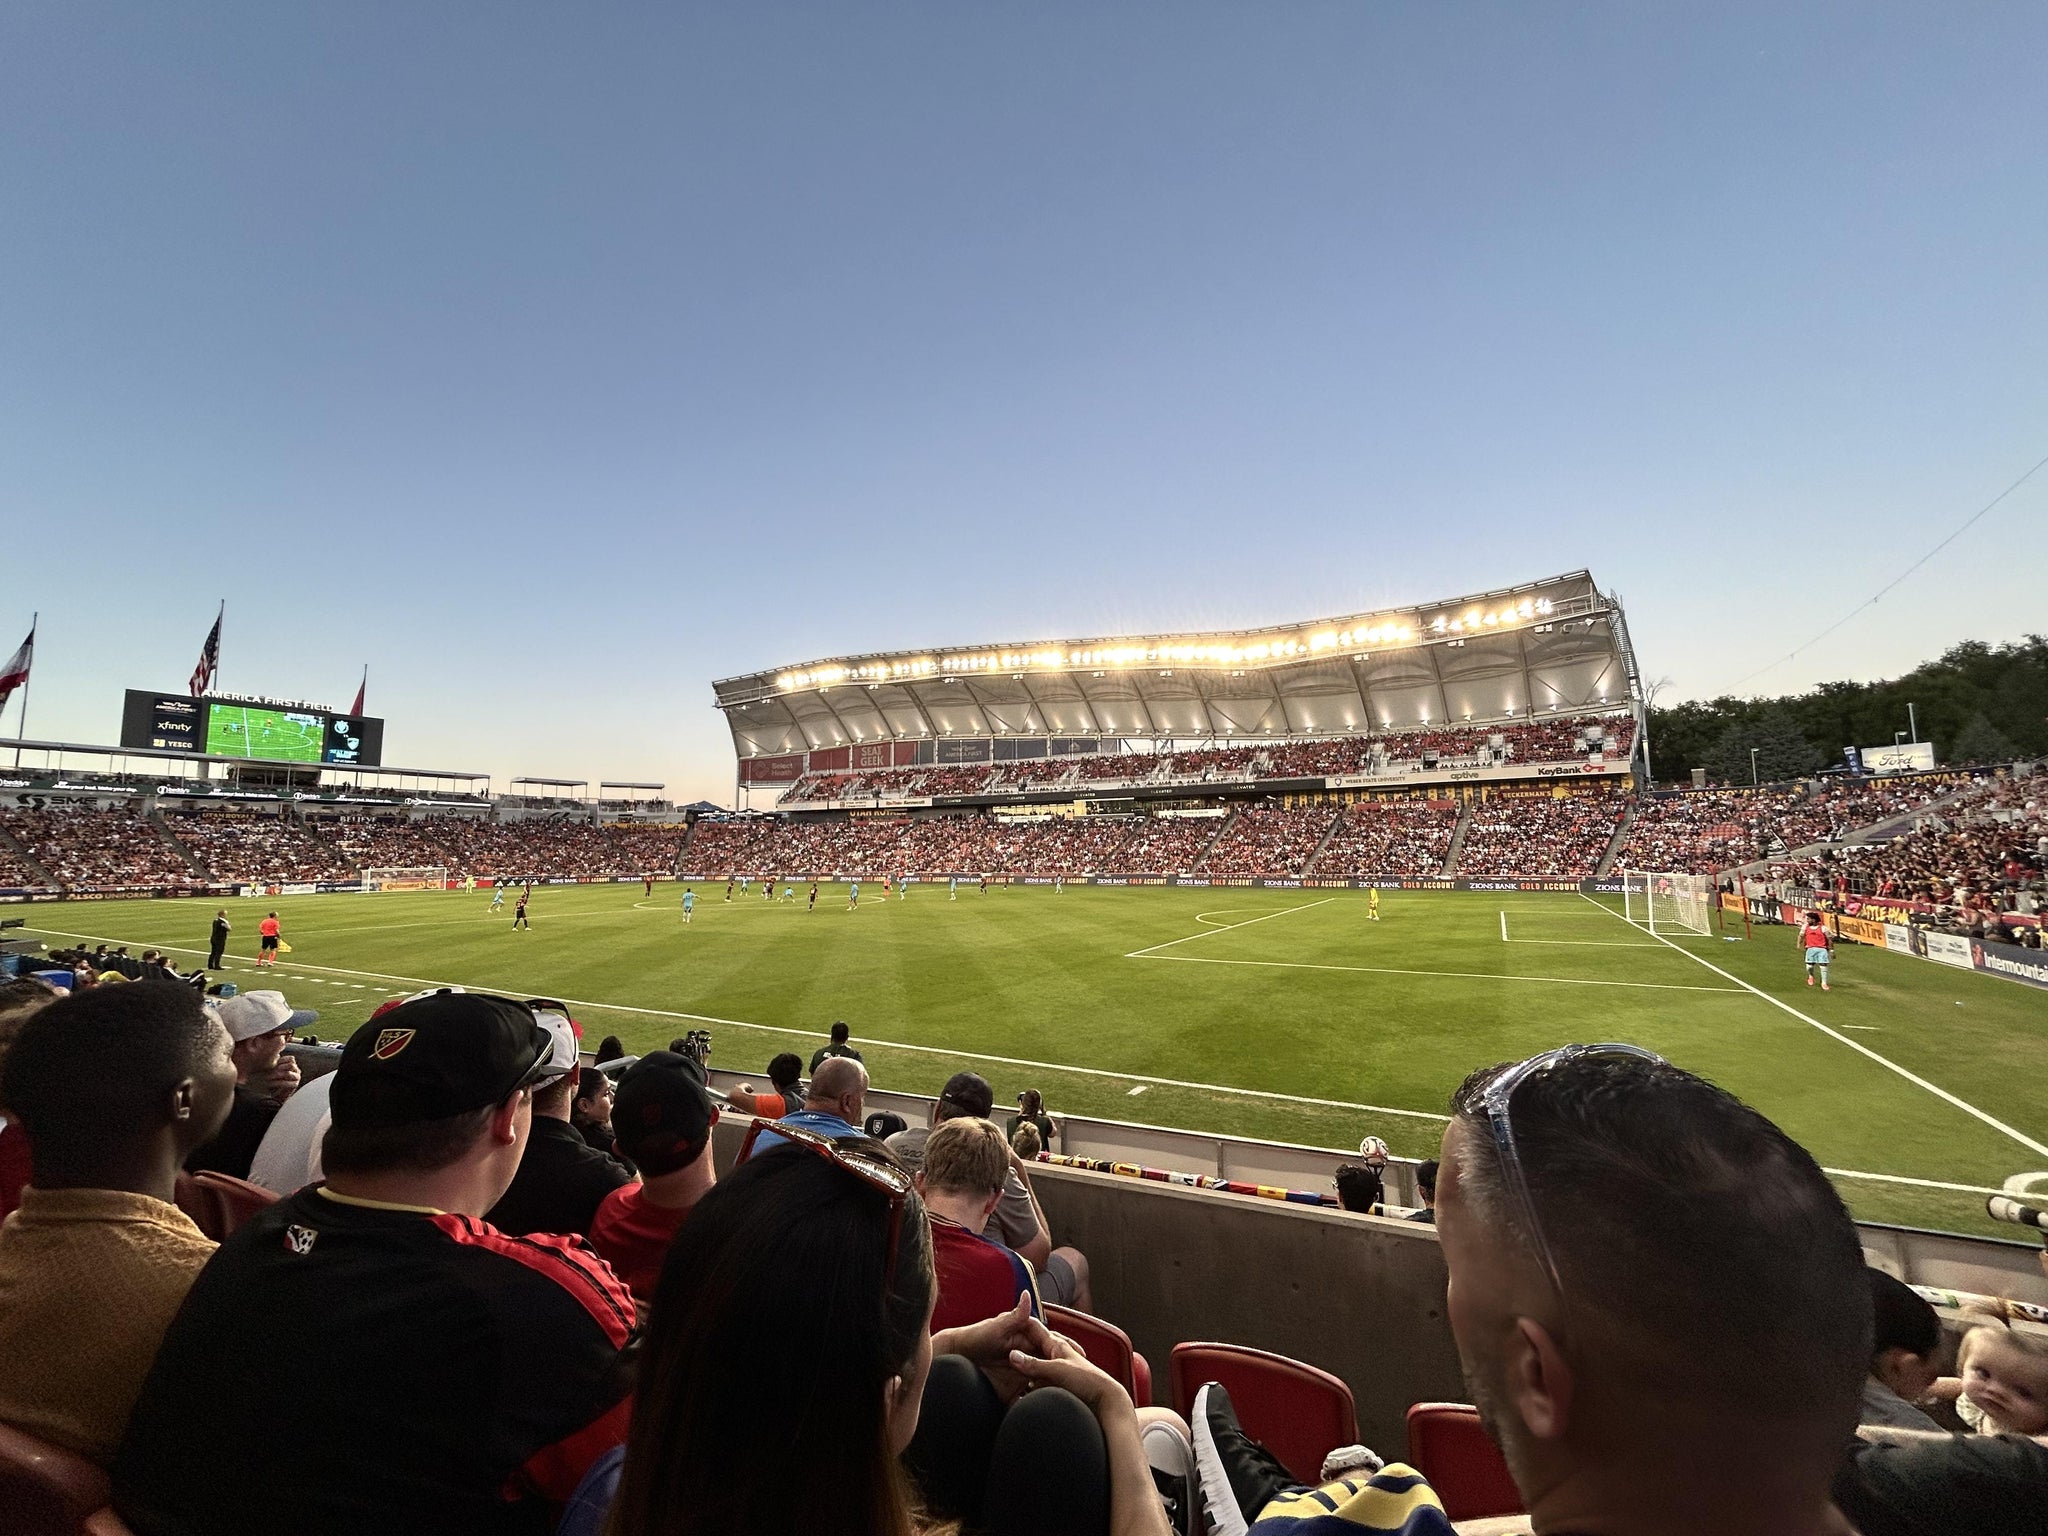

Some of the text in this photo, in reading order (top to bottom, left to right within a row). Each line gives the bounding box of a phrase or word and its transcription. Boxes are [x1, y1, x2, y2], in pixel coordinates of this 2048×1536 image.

[201, 689, 333, 712] AMERICA FIRST FIELD
[157, 721, 192, 732] xfinity
[168, 740, 193, 748] YESCO
[860, 747, 882, 756] SEAT
[860, 756, 884, 766] GEEK
[1879, 753, 1913, 766] Ford
[1451, 771, 1479, 781] aptive
[1538, 766, 1581, 776] KeyBank
[50, 797, 98, 805] SME
[1520, 882, 1540, 890] GOLD
[1544, 882, 1580, 891] ACCOUNT
[1865, 922, 1882, 940] Tire
